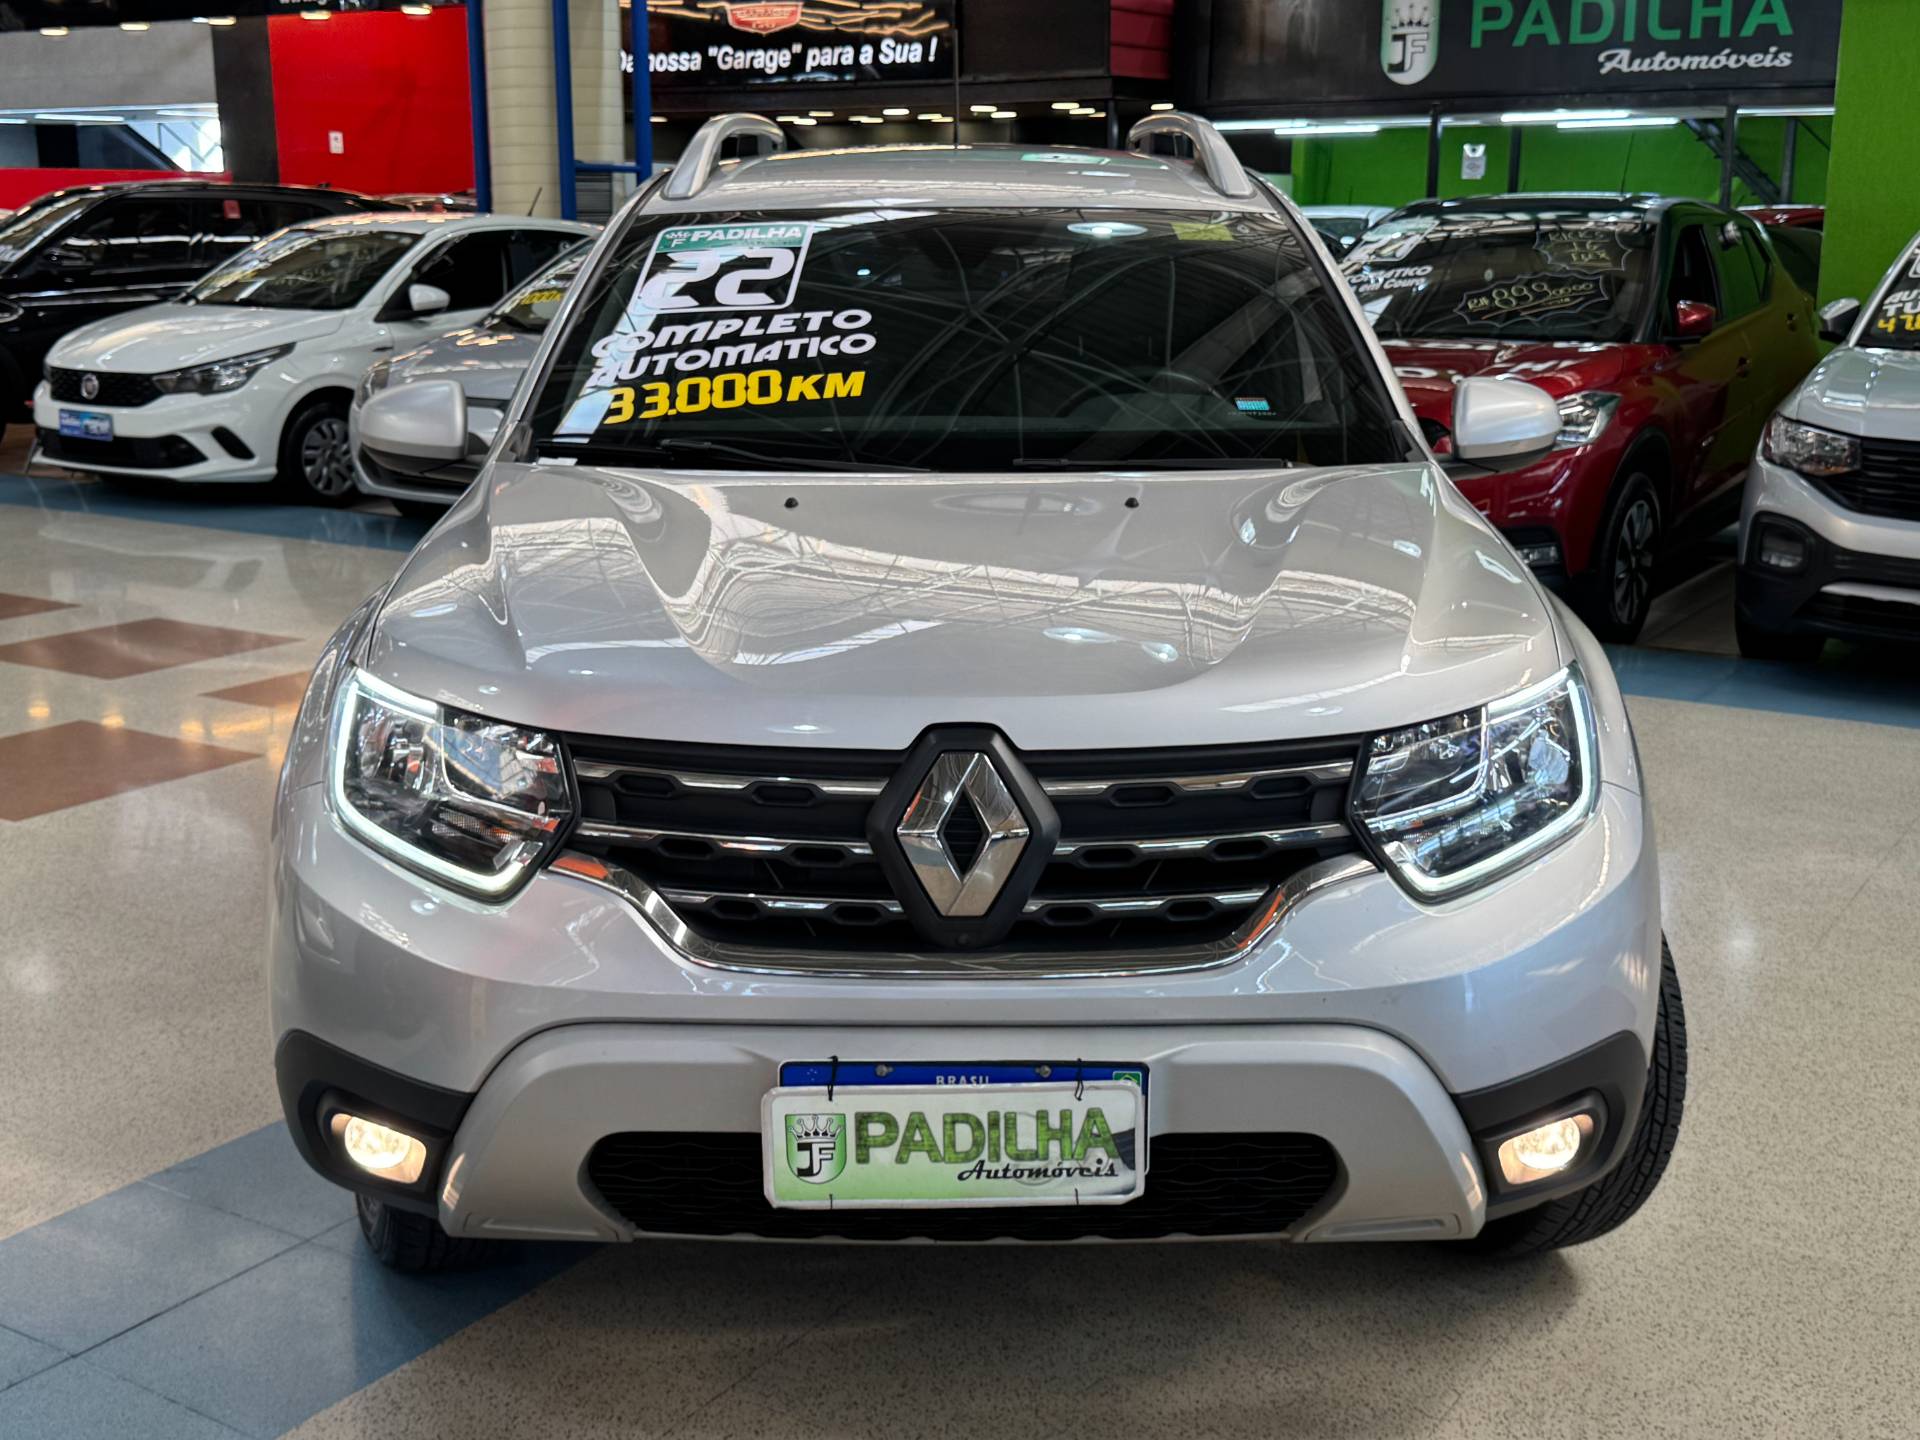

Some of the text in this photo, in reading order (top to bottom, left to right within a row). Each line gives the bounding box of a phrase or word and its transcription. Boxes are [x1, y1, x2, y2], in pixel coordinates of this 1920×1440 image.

[1470, 0, 1794, 48] PADILHA
[708, 42, 803, 74] "Garage"
[805, 44, 855, 71] para
[859, 44, 874, 65] a
[879, 37, 924, 64] Sua
[1598, 46, 1793, 75] Automóveis
[690, 226, 802, 242] PADILHA
[639, 248, 796, 309] 22
[591, 309, 873, 358] COMPLETO
[854, 1107, 1120, 1165] PADILHA
[957, 1157, 1119, 1181] Automóveis
